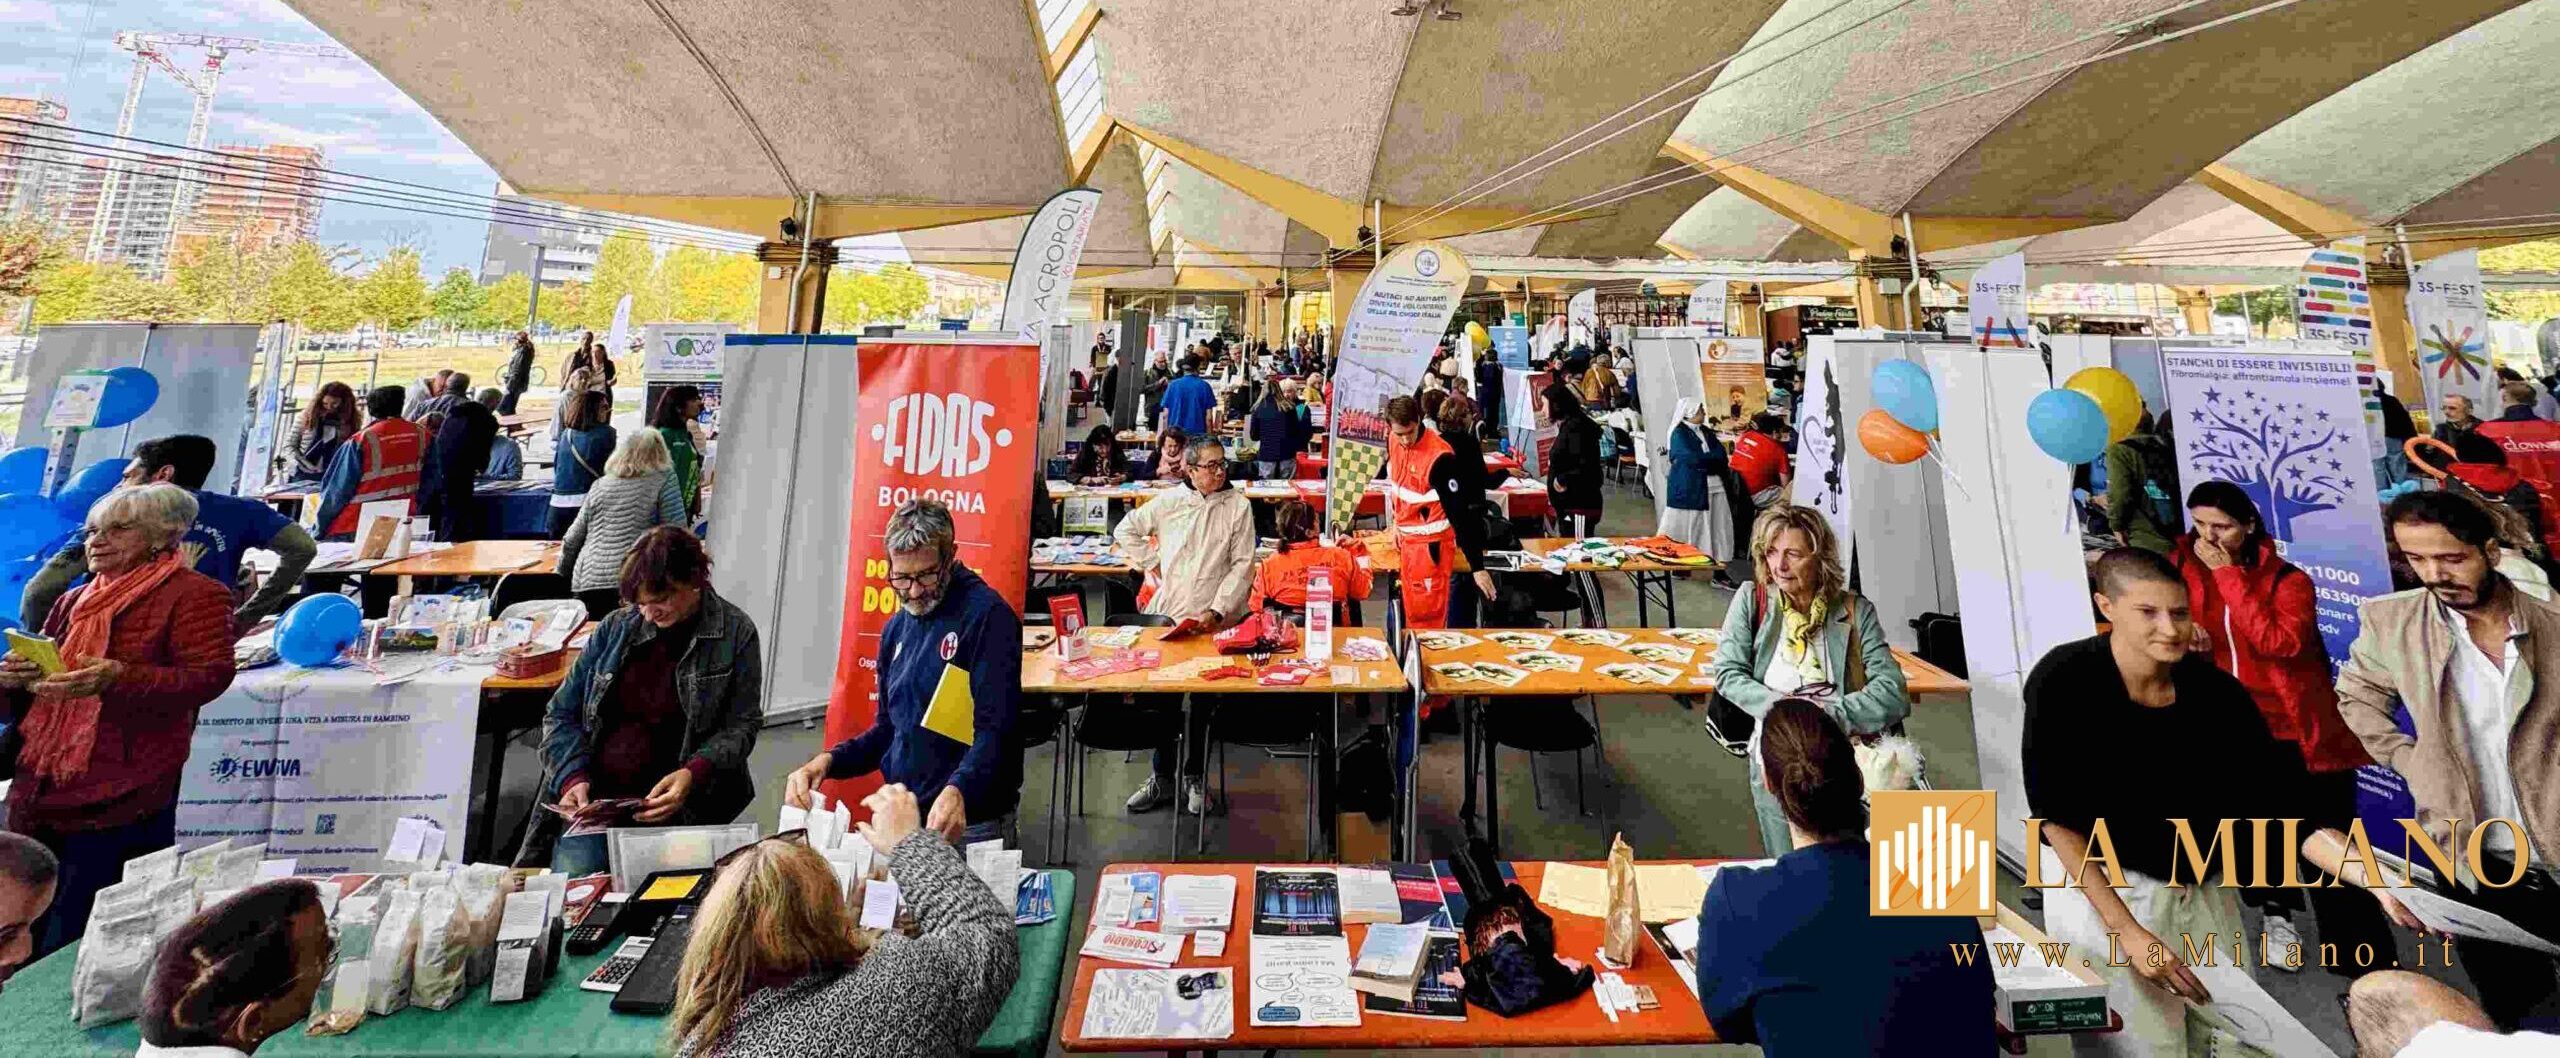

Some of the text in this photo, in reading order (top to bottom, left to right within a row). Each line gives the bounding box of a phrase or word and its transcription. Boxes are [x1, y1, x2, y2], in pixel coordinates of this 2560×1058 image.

[1034, 197, 1082, 312] ACROPOLI
[2167, 357, 2214, 368] STANCHI
[2217, 358, 2230, 369] DI
[2232, 359, 2275, 370] ESSERE
[2232, 372, 2300, 384] affrontiamola
[883, 392, 995, 478] FIDAS
[372, 714, 411, 723] BAMBINO
